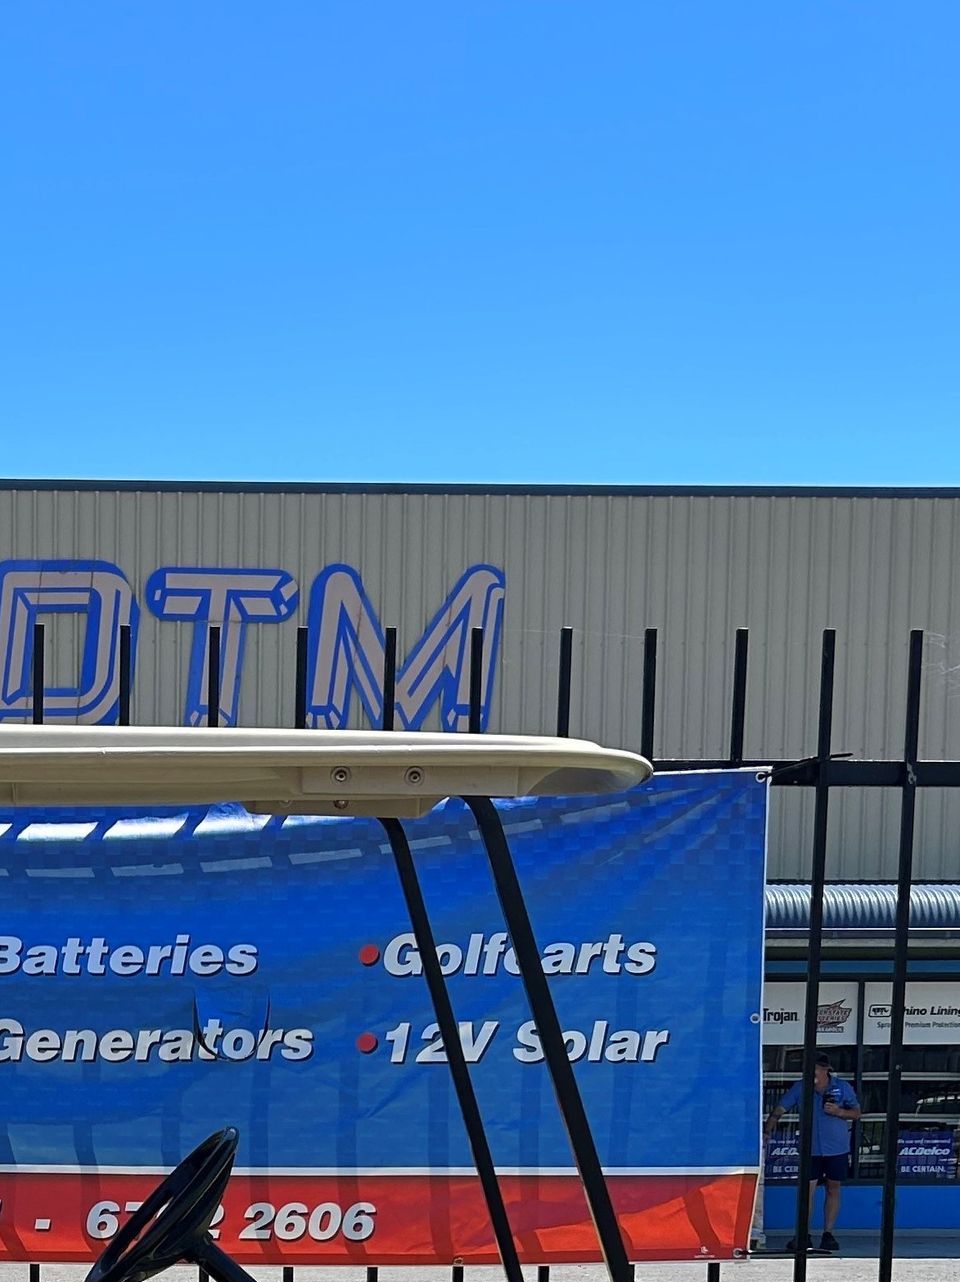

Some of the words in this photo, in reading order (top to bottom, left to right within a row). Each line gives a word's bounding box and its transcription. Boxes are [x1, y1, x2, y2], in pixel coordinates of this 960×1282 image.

[763, 1008, 797, 1024] Trojan
[903, 1006, 927, 1016] hino
[385, 1020, 498, 1063] 12V
[513, 1020, 669, 1062] Solar
[898, 1146, 951, 1156] ACDelco
[239, 1202, 377, 1241] 2606
